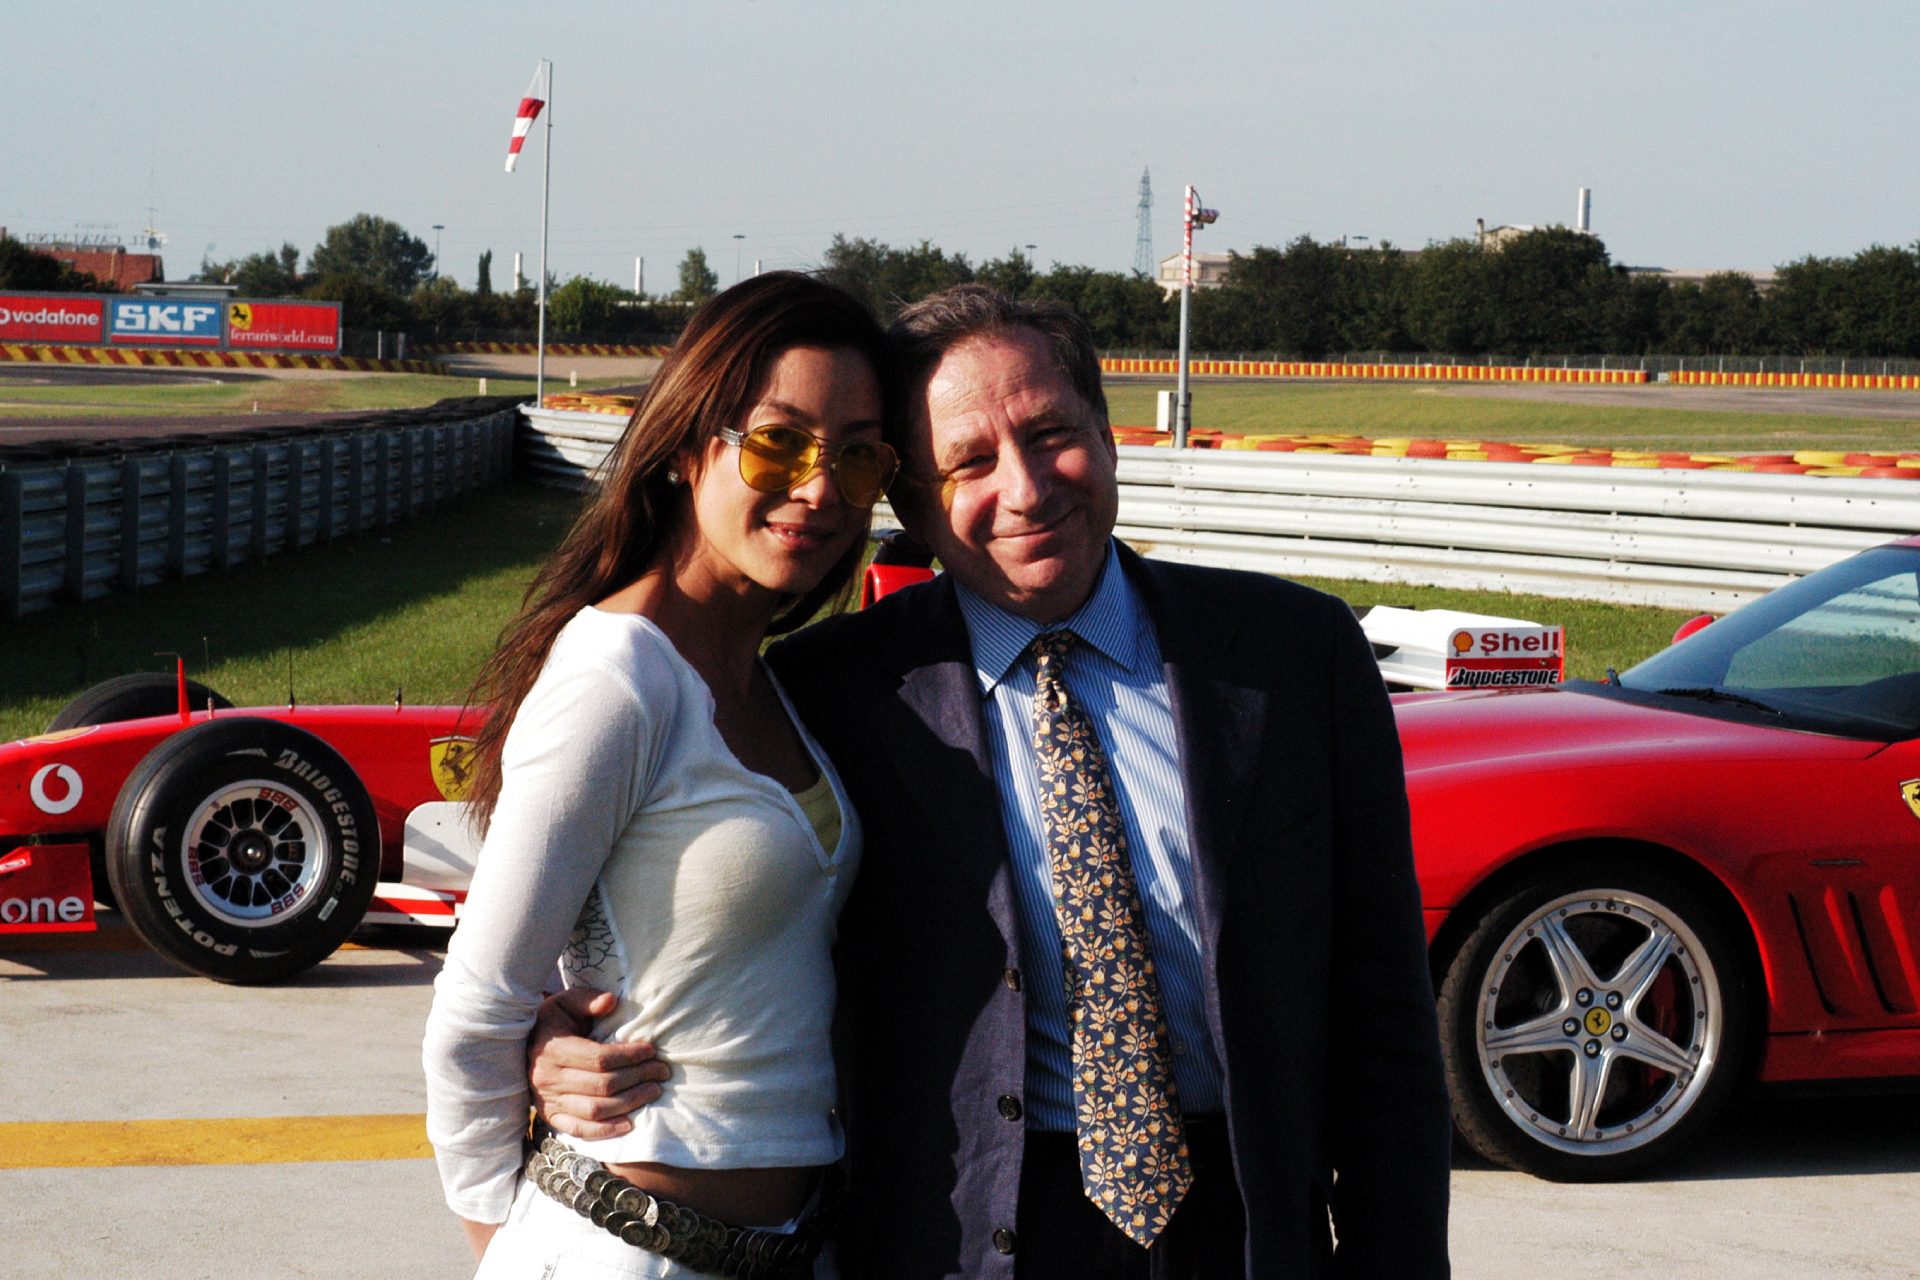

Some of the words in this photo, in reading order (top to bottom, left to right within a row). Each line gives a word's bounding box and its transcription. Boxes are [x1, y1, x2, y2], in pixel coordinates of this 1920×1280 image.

[13, 308, 99, 326] vodafone
[115, 304, 216, 332] SKF
[230, 327, 334, 345] ferrariworld.com
[1480, 631, 1559, 652] Shell
[151, 826, 239, 957] POTENZA
